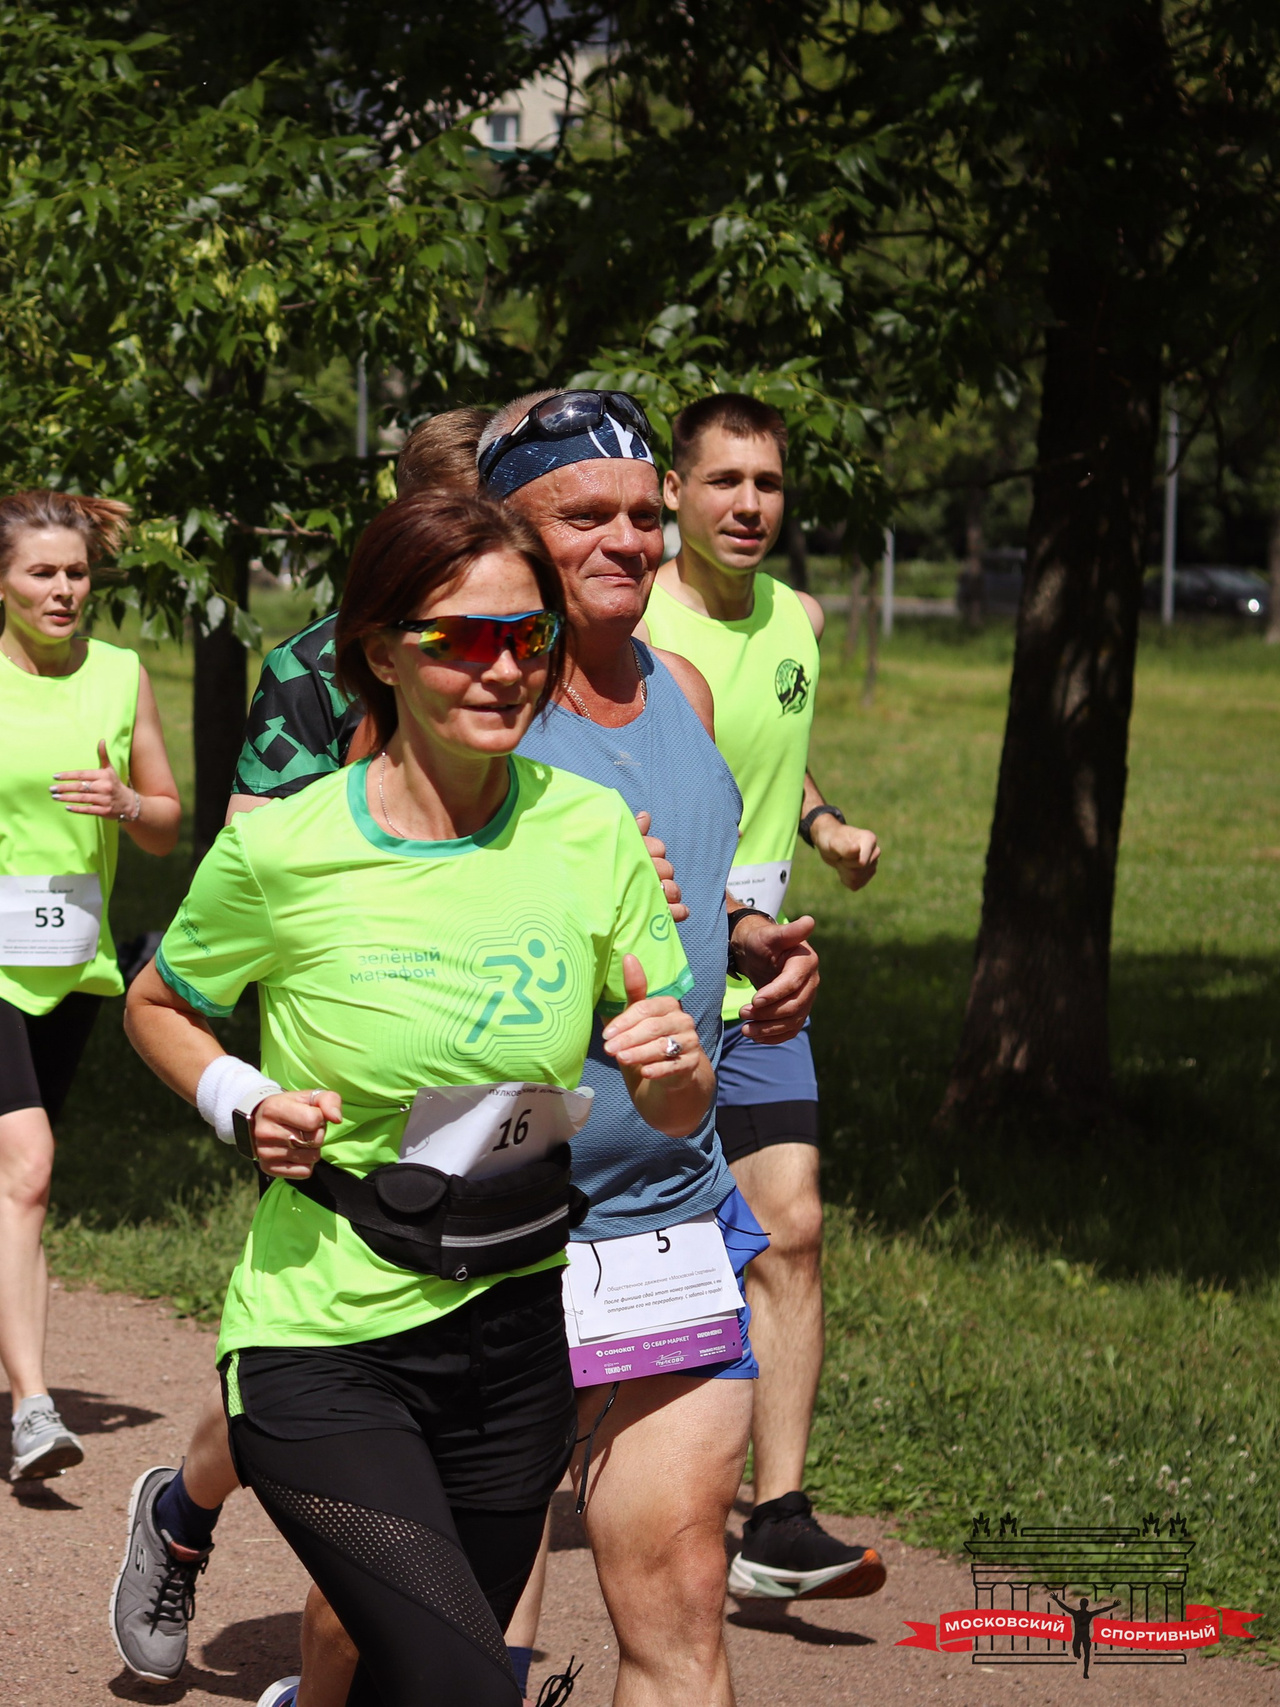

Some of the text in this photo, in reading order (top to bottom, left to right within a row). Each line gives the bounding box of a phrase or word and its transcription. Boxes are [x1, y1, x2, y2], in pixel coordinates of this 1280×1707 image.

[35, 907, 65, 928] 53
[358, 946, 441, 966] зелёный
[350, 965, 436, 984] марафон
[492, 1109, 532, 1152] 16
[656, 1228, 671, 1253] 5
[607, 1282, 644, 1292] Общественное
[644, 1277, 668, 1286] движение
[607, 1305, 635, 1313] отправим
